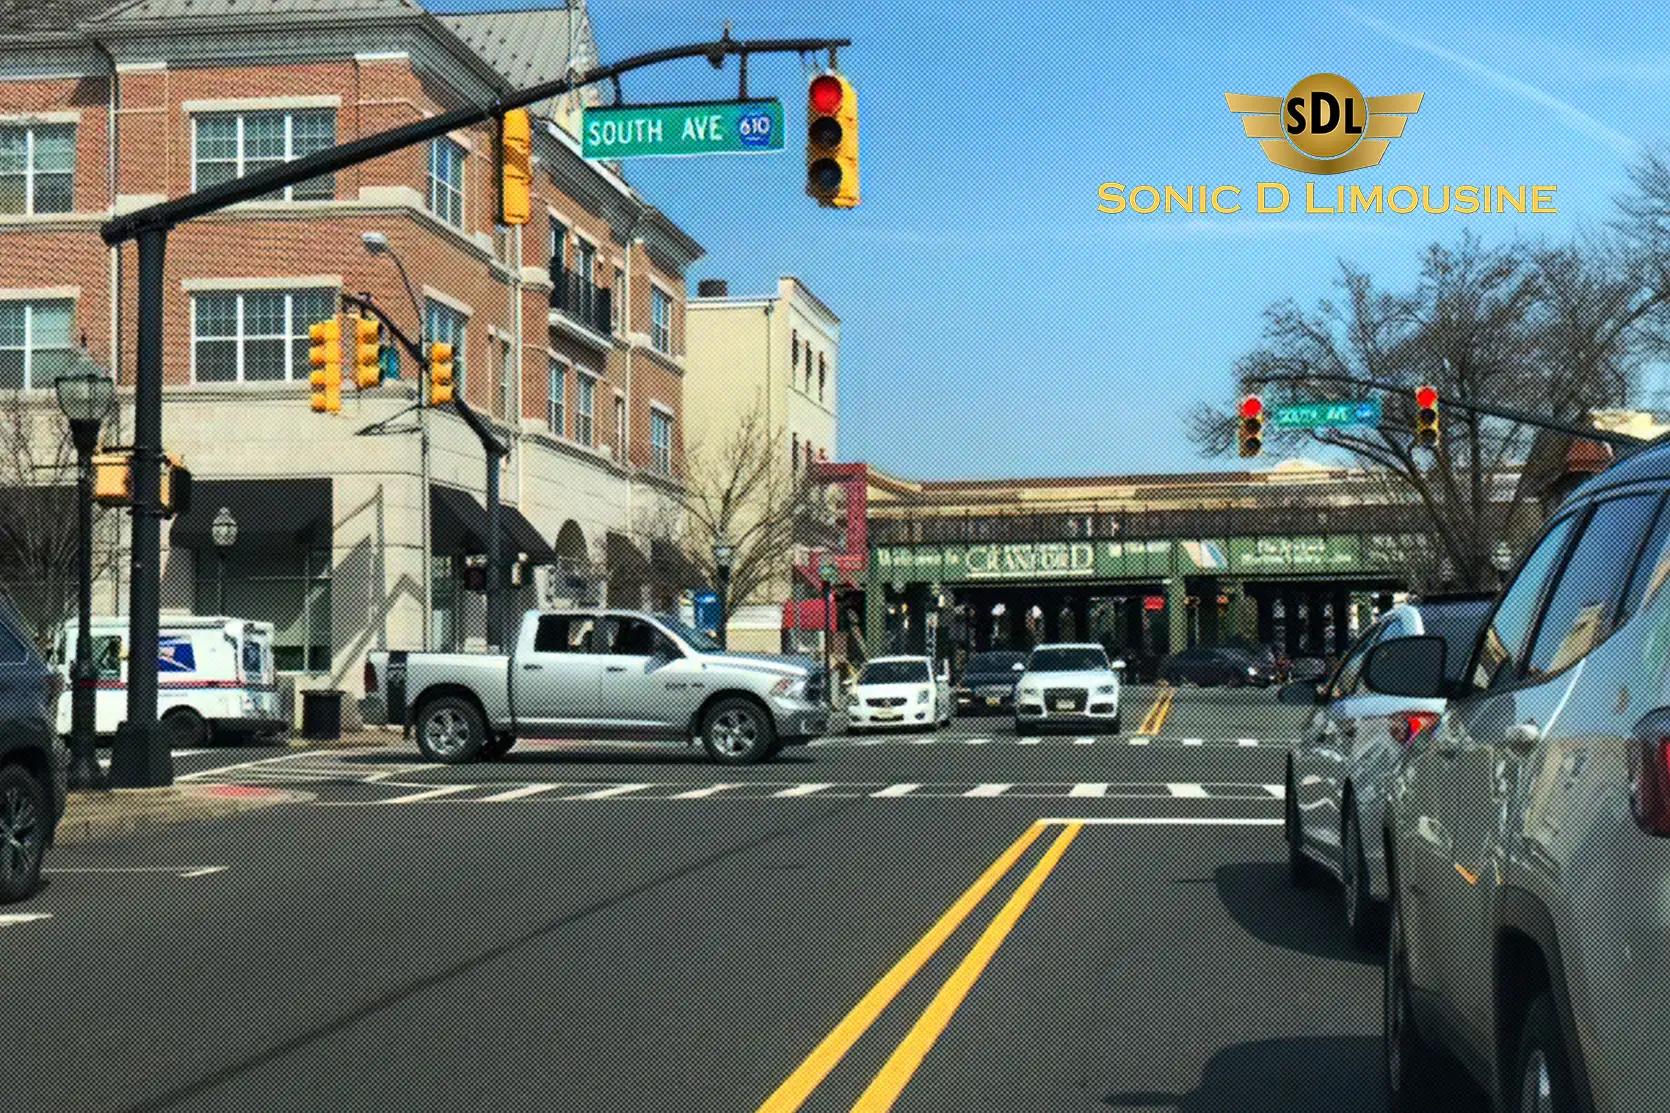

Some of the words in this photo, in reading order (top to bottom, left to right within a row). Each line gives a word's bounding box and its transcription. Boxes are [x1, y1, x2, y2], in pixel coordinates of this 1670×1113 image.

[589, 119, 663, 146] SOUTH
[681, 115, 723, 142] AVE
[739, 116, 770, 136] 610
